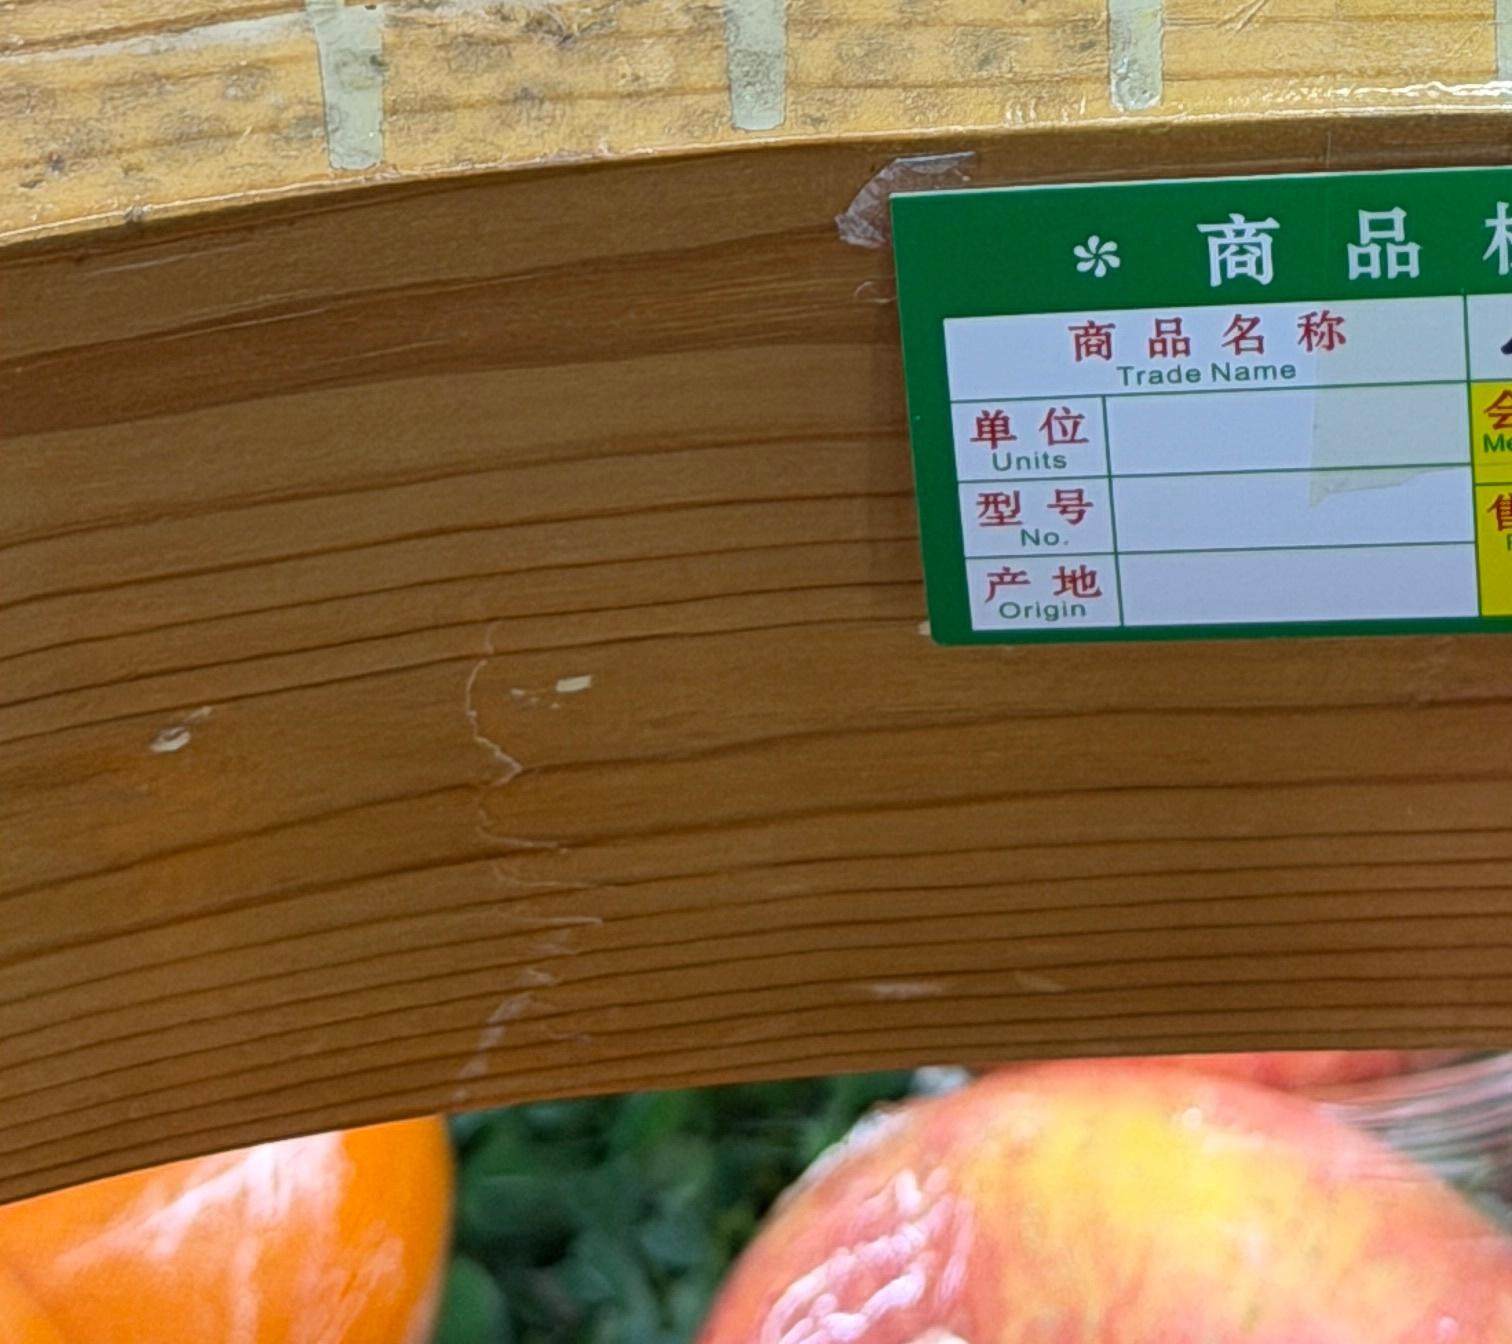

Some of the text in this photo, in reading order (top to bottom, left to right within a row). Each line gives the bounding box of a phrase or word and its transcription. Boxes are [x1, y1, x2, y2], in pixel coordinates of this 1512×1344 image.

[1069, 310, 1346, 362] 商品名称
[1116, 361, 1297, 387] Trade Name
[969, 407, 1089, 449] 单位
[992, 451, 1067, 472] Units
[976, 488, 1093, 527] 型号
[1020, 529, 1070, 547] No.
[984, 565, 1103, 602] 产地
[999, 600, 1087, 622] Origin
